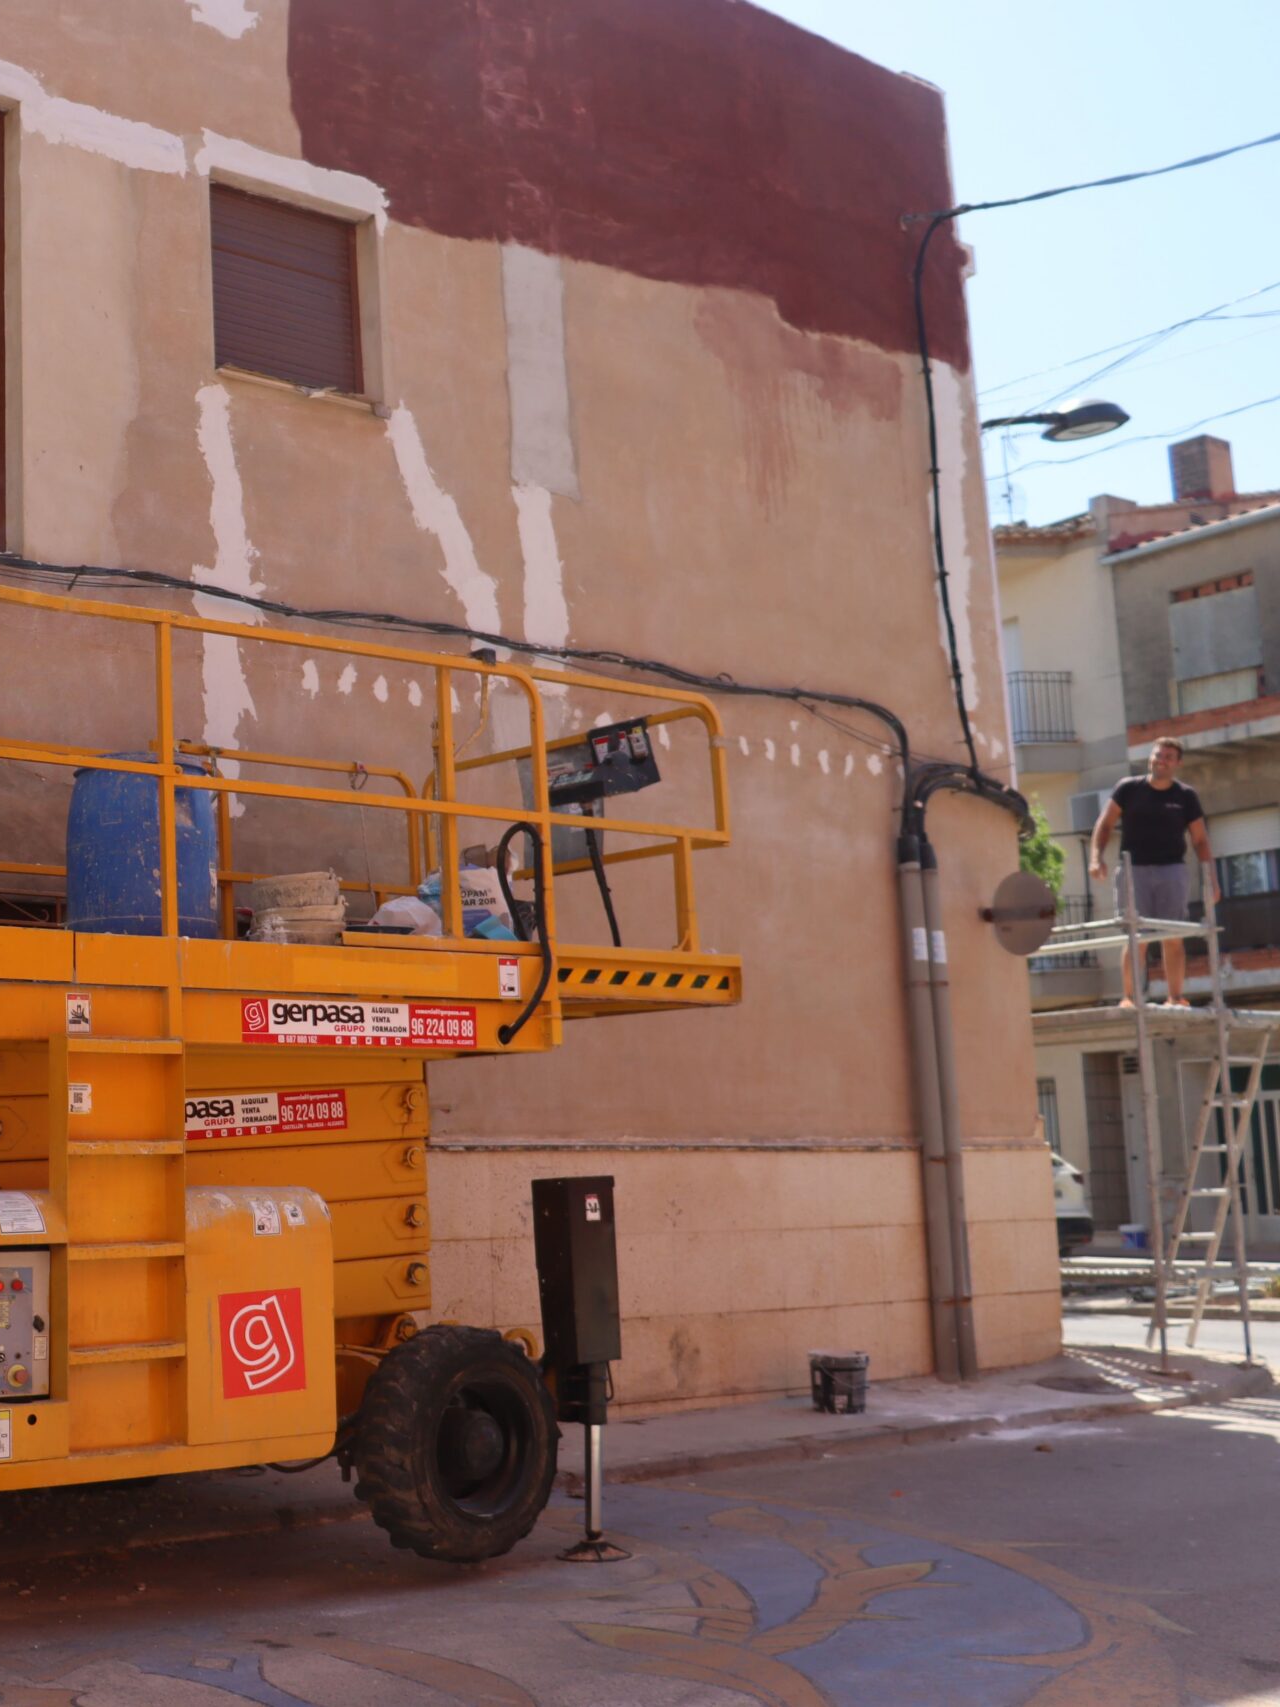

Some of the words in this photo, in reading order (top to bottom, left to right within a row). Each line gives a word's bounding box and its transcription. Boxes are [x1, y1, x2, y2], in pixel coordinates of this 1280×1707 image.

[272, 1003, 365, 1026] gerpasa
[334, 1024, 365, 1033] GRUPO
[371, 1025, 408, 1033] FORMACIÓN
[411, 1018, 424, 1036] 96
[426, 1018, 445, 1036] 224
[447, 1019, 459, 1036] 09
[461, 1019, 474, 1038] 88
[241, 1097, 269, 1105] ALQUILER
[185, 1099, 235, 1123] pasa
[281, 1105, 294, 1122] 96
[296, 1103, 314, 1121] 224
[316, 1102, 328, 1119] 09
[330, 1101, 344, 1118] 88
[204, 1117, 235, 1127] GRUPO
[242, 1114, 277, 1123] FORMACIÓN
